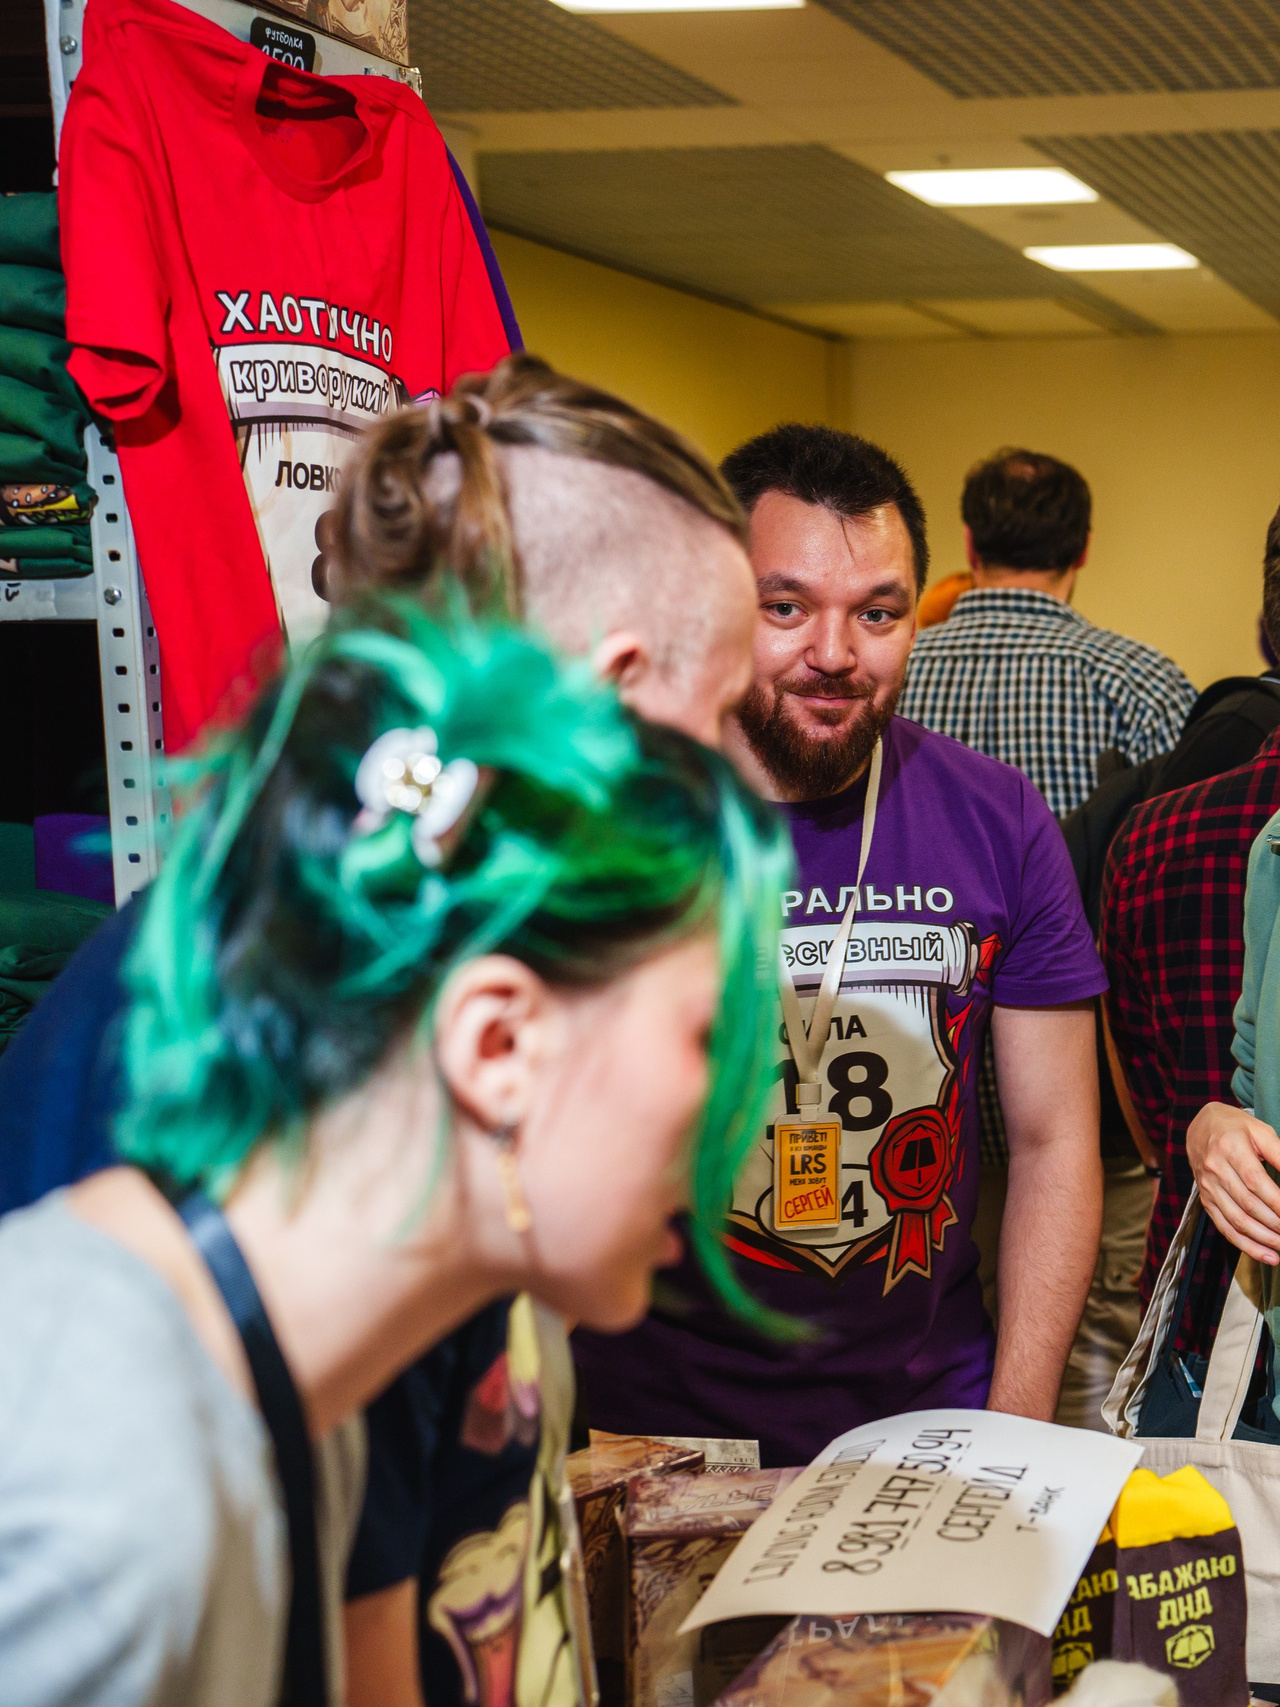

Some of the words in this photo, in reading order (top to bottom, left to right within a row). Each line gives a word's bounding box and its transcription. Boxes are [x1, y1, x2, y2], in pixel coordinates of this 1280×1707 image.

[264, 27, 304, 50] ФУТБОЛКА
[215, 290, 393, 365] ХАОТИЧНО
[230, 358, 391, 416] криворукий
[789, 1131, 828, 1144] ПРИВЕТ!
[790, 1153, 826, 1175] LRS
[784, 1185, 834, 1219] СЕРГЕЙ
[912, 1429, 972, 1451] 94
[896, 1452, 951, 1475] 50
[863, 1475, 935, 1513] 747
[937, 1478, 1018, 1542] СЕРГЕЙ
[837, 1519, 909, 1556] 981
[821, 1558, 882, 1575] 8
[1069, 1568, 1118, 1604] АЮ
[1157, 1586, 1213, 1630] ДНД
